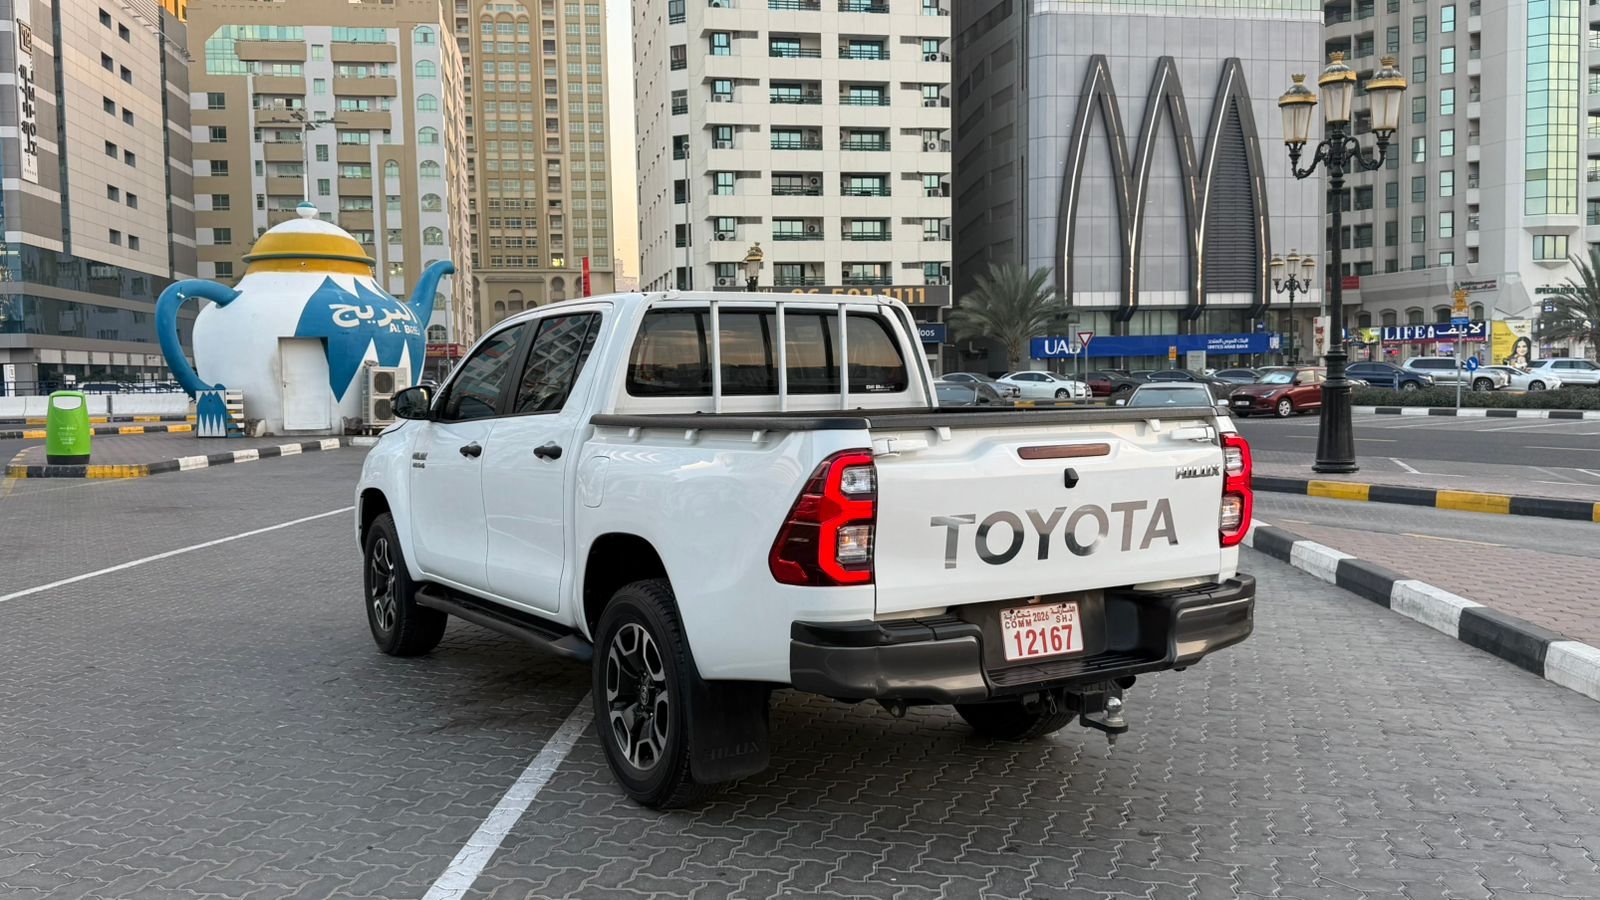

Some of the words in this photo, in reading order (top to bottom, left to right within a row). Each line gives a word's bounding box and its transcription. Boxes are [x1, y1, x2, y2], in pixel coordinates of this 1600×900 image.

[27, 70, 38, 157] HOTEL
[389, 322, 401, 333] AL
[1384, 325, 1425, 340] LIFE
[1175, 464, 1220, 480] HILUX
[930, 498, 1179, 569] TOYOTA
[1004, 619, 1032, 629] COMM
[1033, 611, 1050, 622] 2026
[1056, 614, 1073, 623] SHJ
[1014, 624, 1073, 656] 12167
